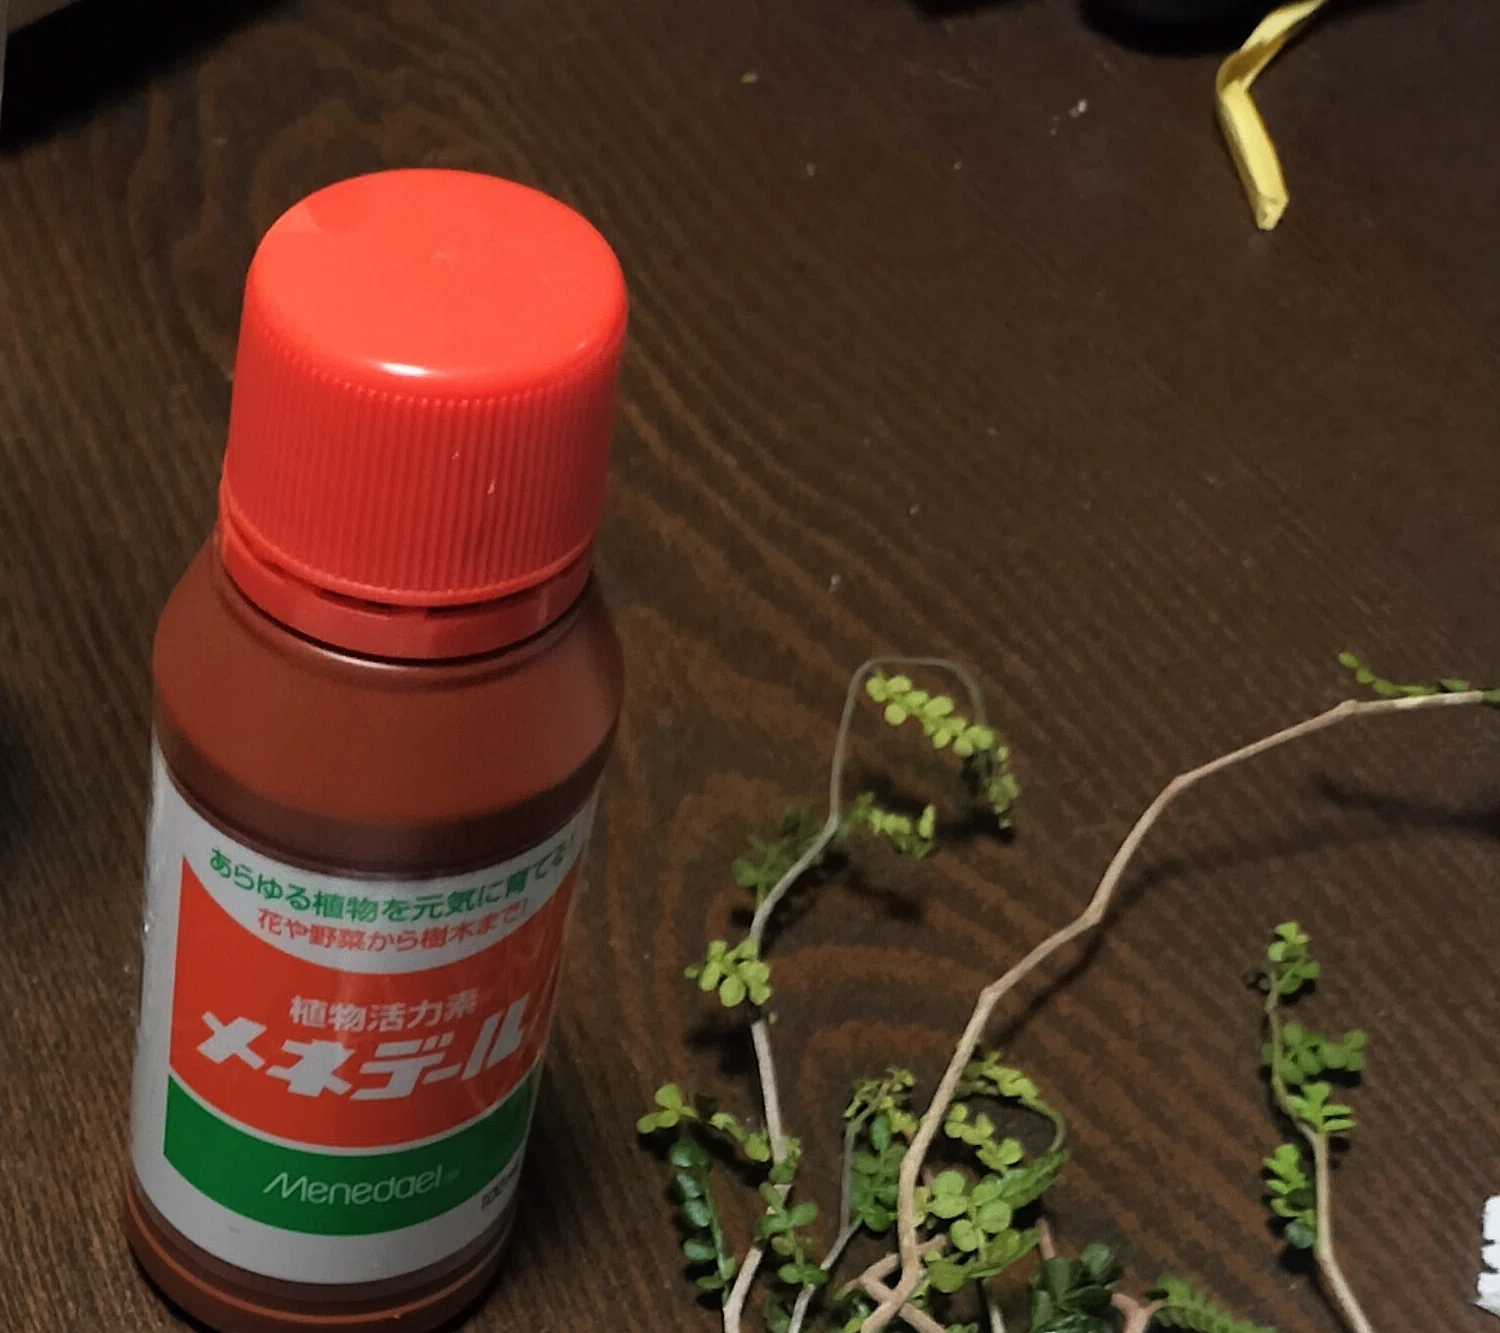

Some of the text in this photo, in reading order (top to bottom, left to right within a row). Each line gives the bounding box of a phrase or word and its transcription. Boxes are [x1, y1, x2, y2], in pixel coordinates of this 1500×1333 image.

[289, 988, 478, 1032] 植物活力素
[197, 992, 529, 1099] メネデール
[263, 1164, 443, 1205] Menedael
